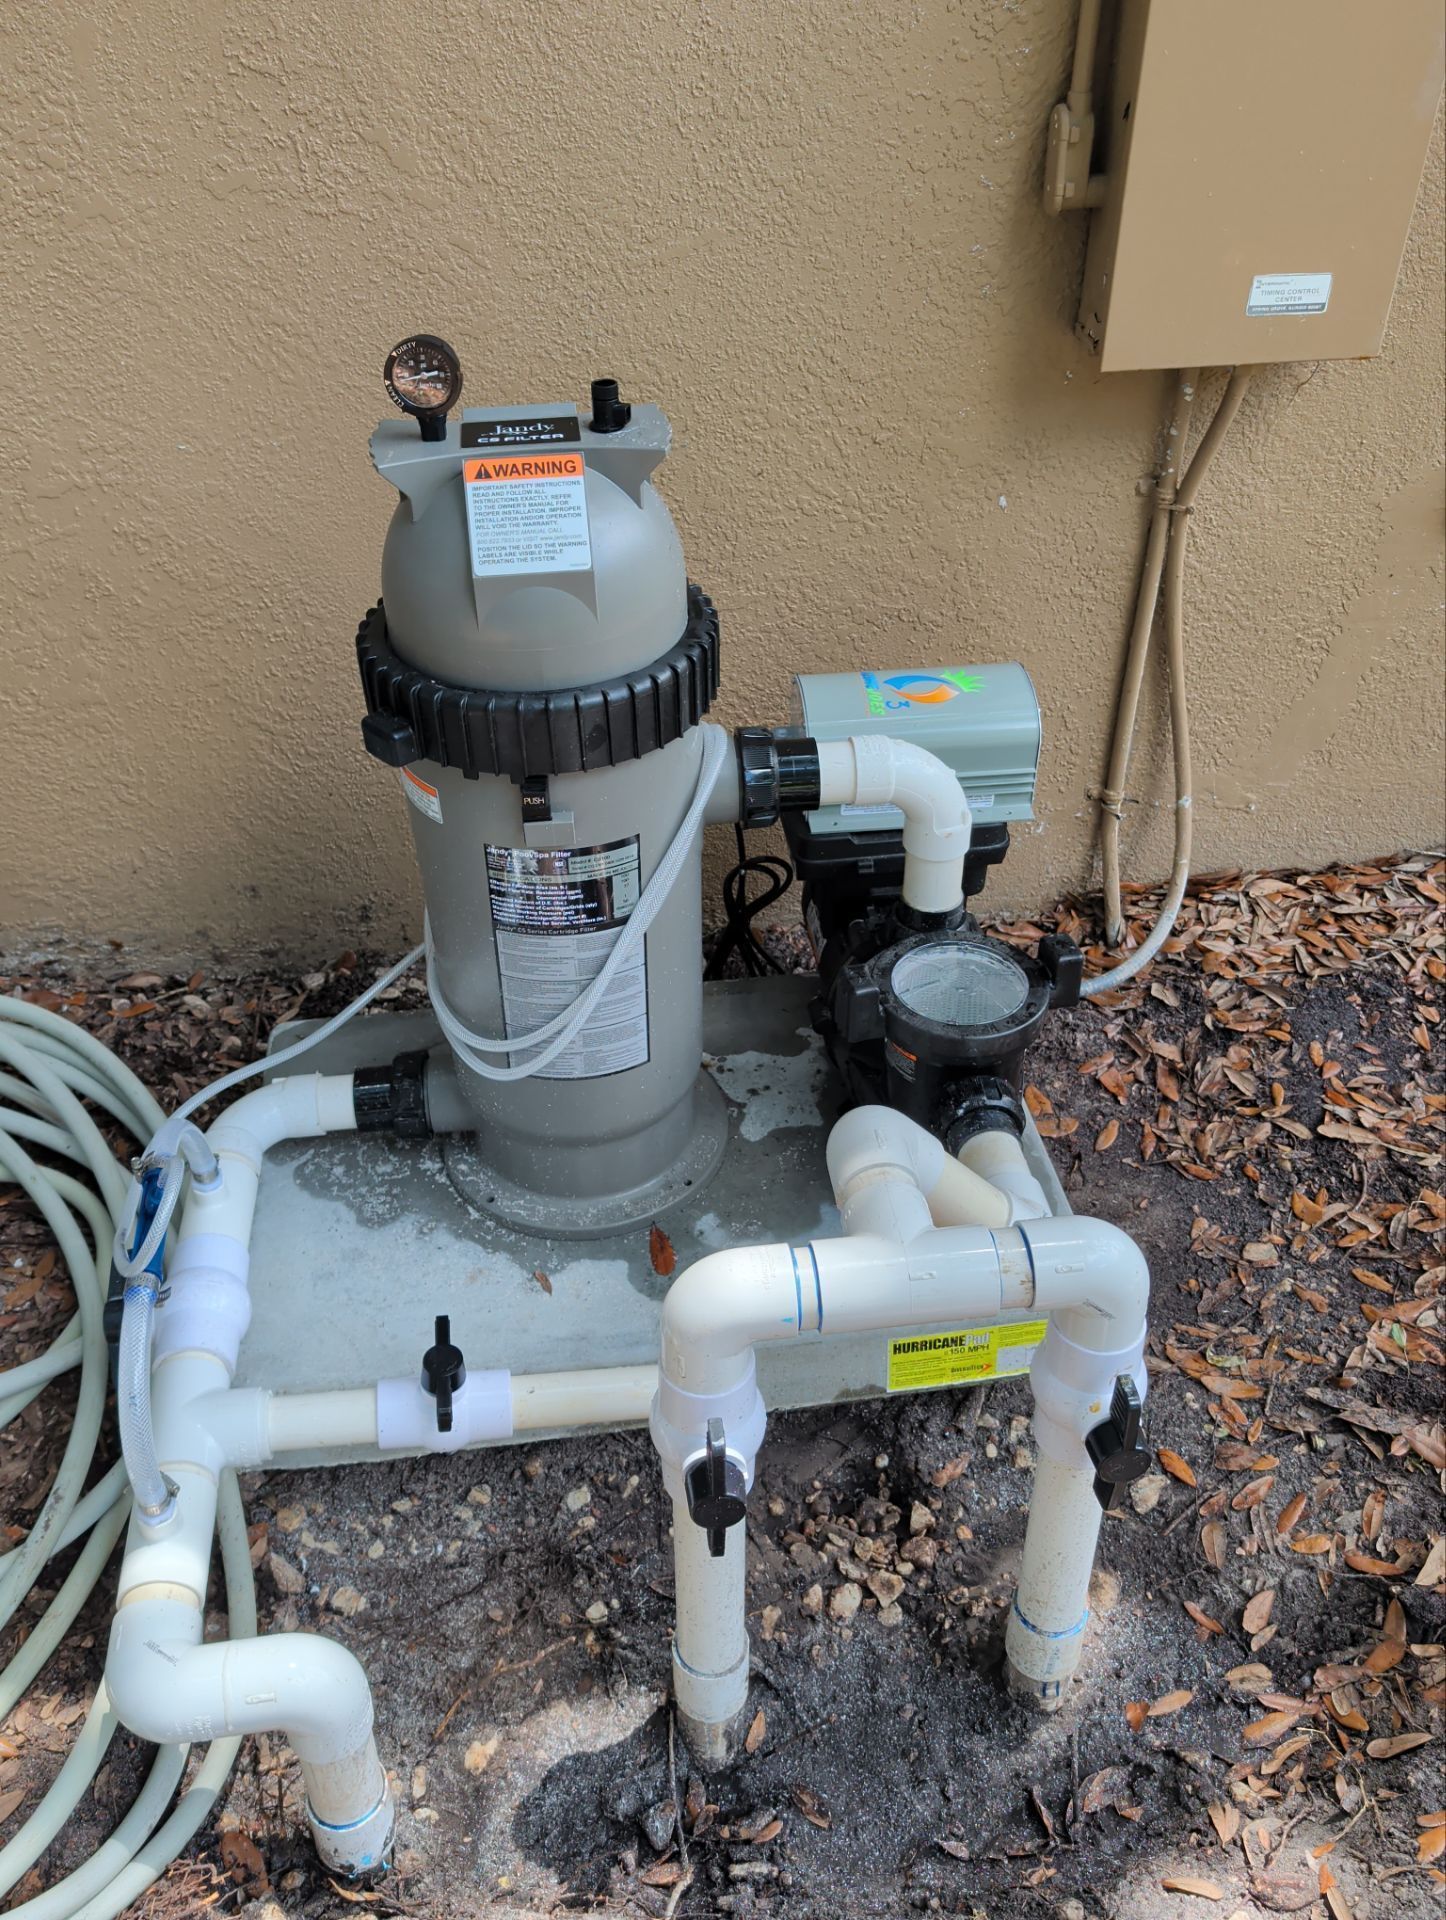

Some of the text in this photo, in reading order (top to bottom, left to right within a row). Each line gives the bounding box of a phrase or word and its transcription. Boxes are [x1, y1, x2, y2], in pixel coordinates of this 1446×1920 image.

[395, 341, 416, 356] DIRTY
[387, 386, 405, 408] CLEAN
[495, 422, 554, 436] Jandy
[503, 433, 564, 442] FILTER
[492, 460, 577, 478] WARNING
[472, 484, 508, 492] IMPORTANT
[509, 482, 534, 490] SAFETY
[472, 490, 490, 498] READ
[473, 496, 520, 504] INSTRUCTIONS
[498, 502, 526, 510] OWNER'S
[546, 512, 582, 520] OPERATION
[520, 528, 546, 536] MANUAL
[477, 545, 507, 553] POSITION
[557, 540, 588, 548] WARNING
[478, 558, 515, 566] OPERATING
[550, 851, 571, 859] Filter
[967, 1344, 990, 1354] MPH
